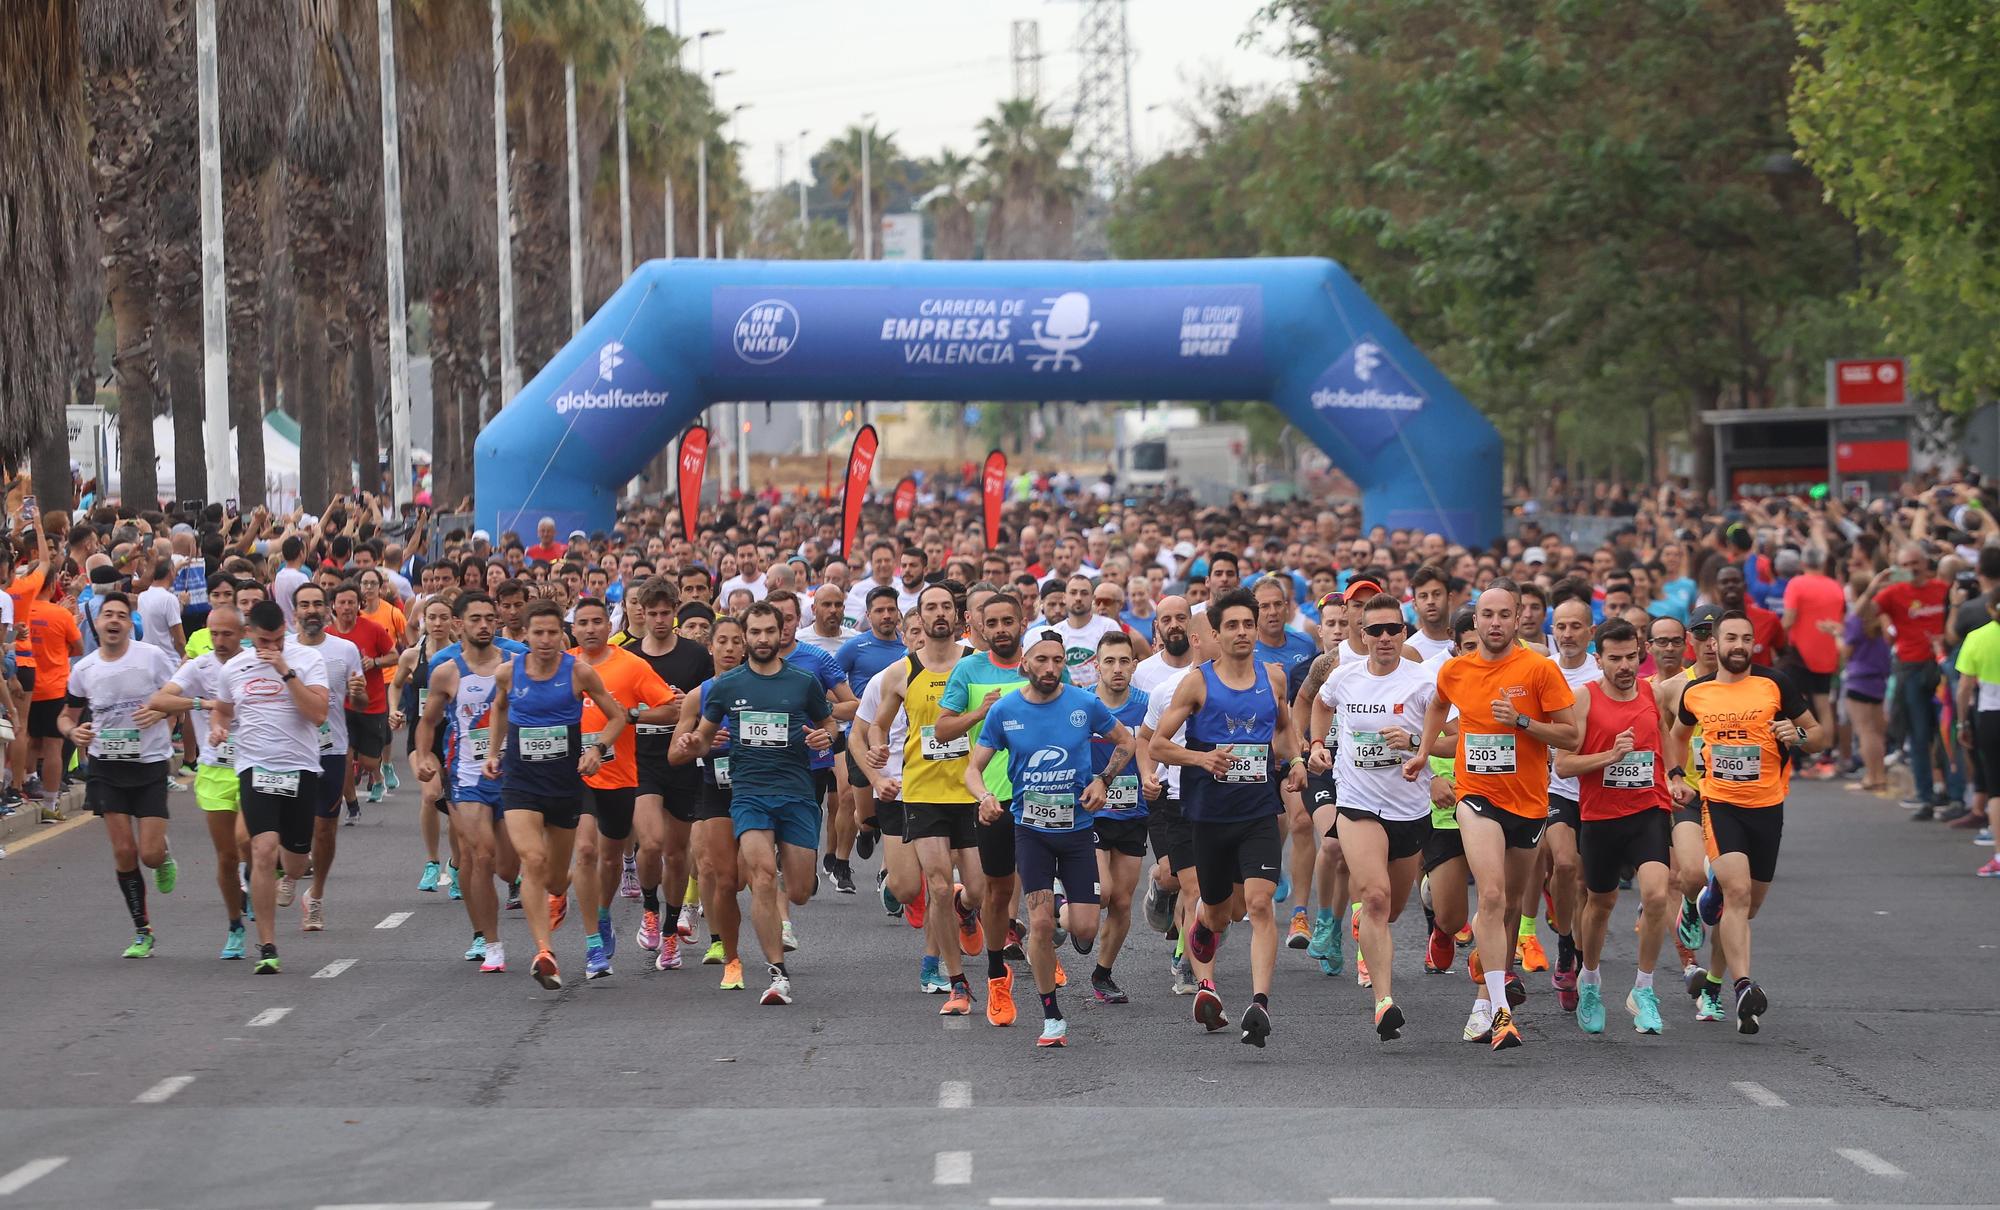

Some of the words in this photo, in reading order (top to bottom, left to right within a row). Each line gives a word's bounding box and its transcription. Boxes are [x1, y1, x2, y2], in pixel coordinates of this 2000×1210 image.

[919, 299, 997, 317] CARRERA
[1000, 299, 1026, 317] DE
[751, 306, 785, 323] #BE
[738, 321, 776, 338] RUN
[880, 317, 1012, 341] EMPRESAS
[742, 336, 789, 353] NKER
[903, 342, 1016, 365] VALENCIA
[555, 387, 670, 415] globalfactor
[1310, 386, 1424, 411] globalfactor
[1345, 703, 1387, 714] TECLISA
[748, 725, 768, 736] 106
[1717, 730, 1748, 740] PCS
[102, 741, 126, 751] 1527
[222, 745, 236, 756] 15
[524, 740, 552, 751] 1969
[1356, 746, 1385, 757] 1642
[1469, 749, 1497, 761] 2503
[1228, 760, 1251, 771] 968
[1715, 758, 1744, 771] 2060
[1022, 768, 1077, 783] POWER
[1609, 765, 1640, 777] 2968
[257, 774, 284, 785] 2280
[1028, 804, 1057, 819] 1296
